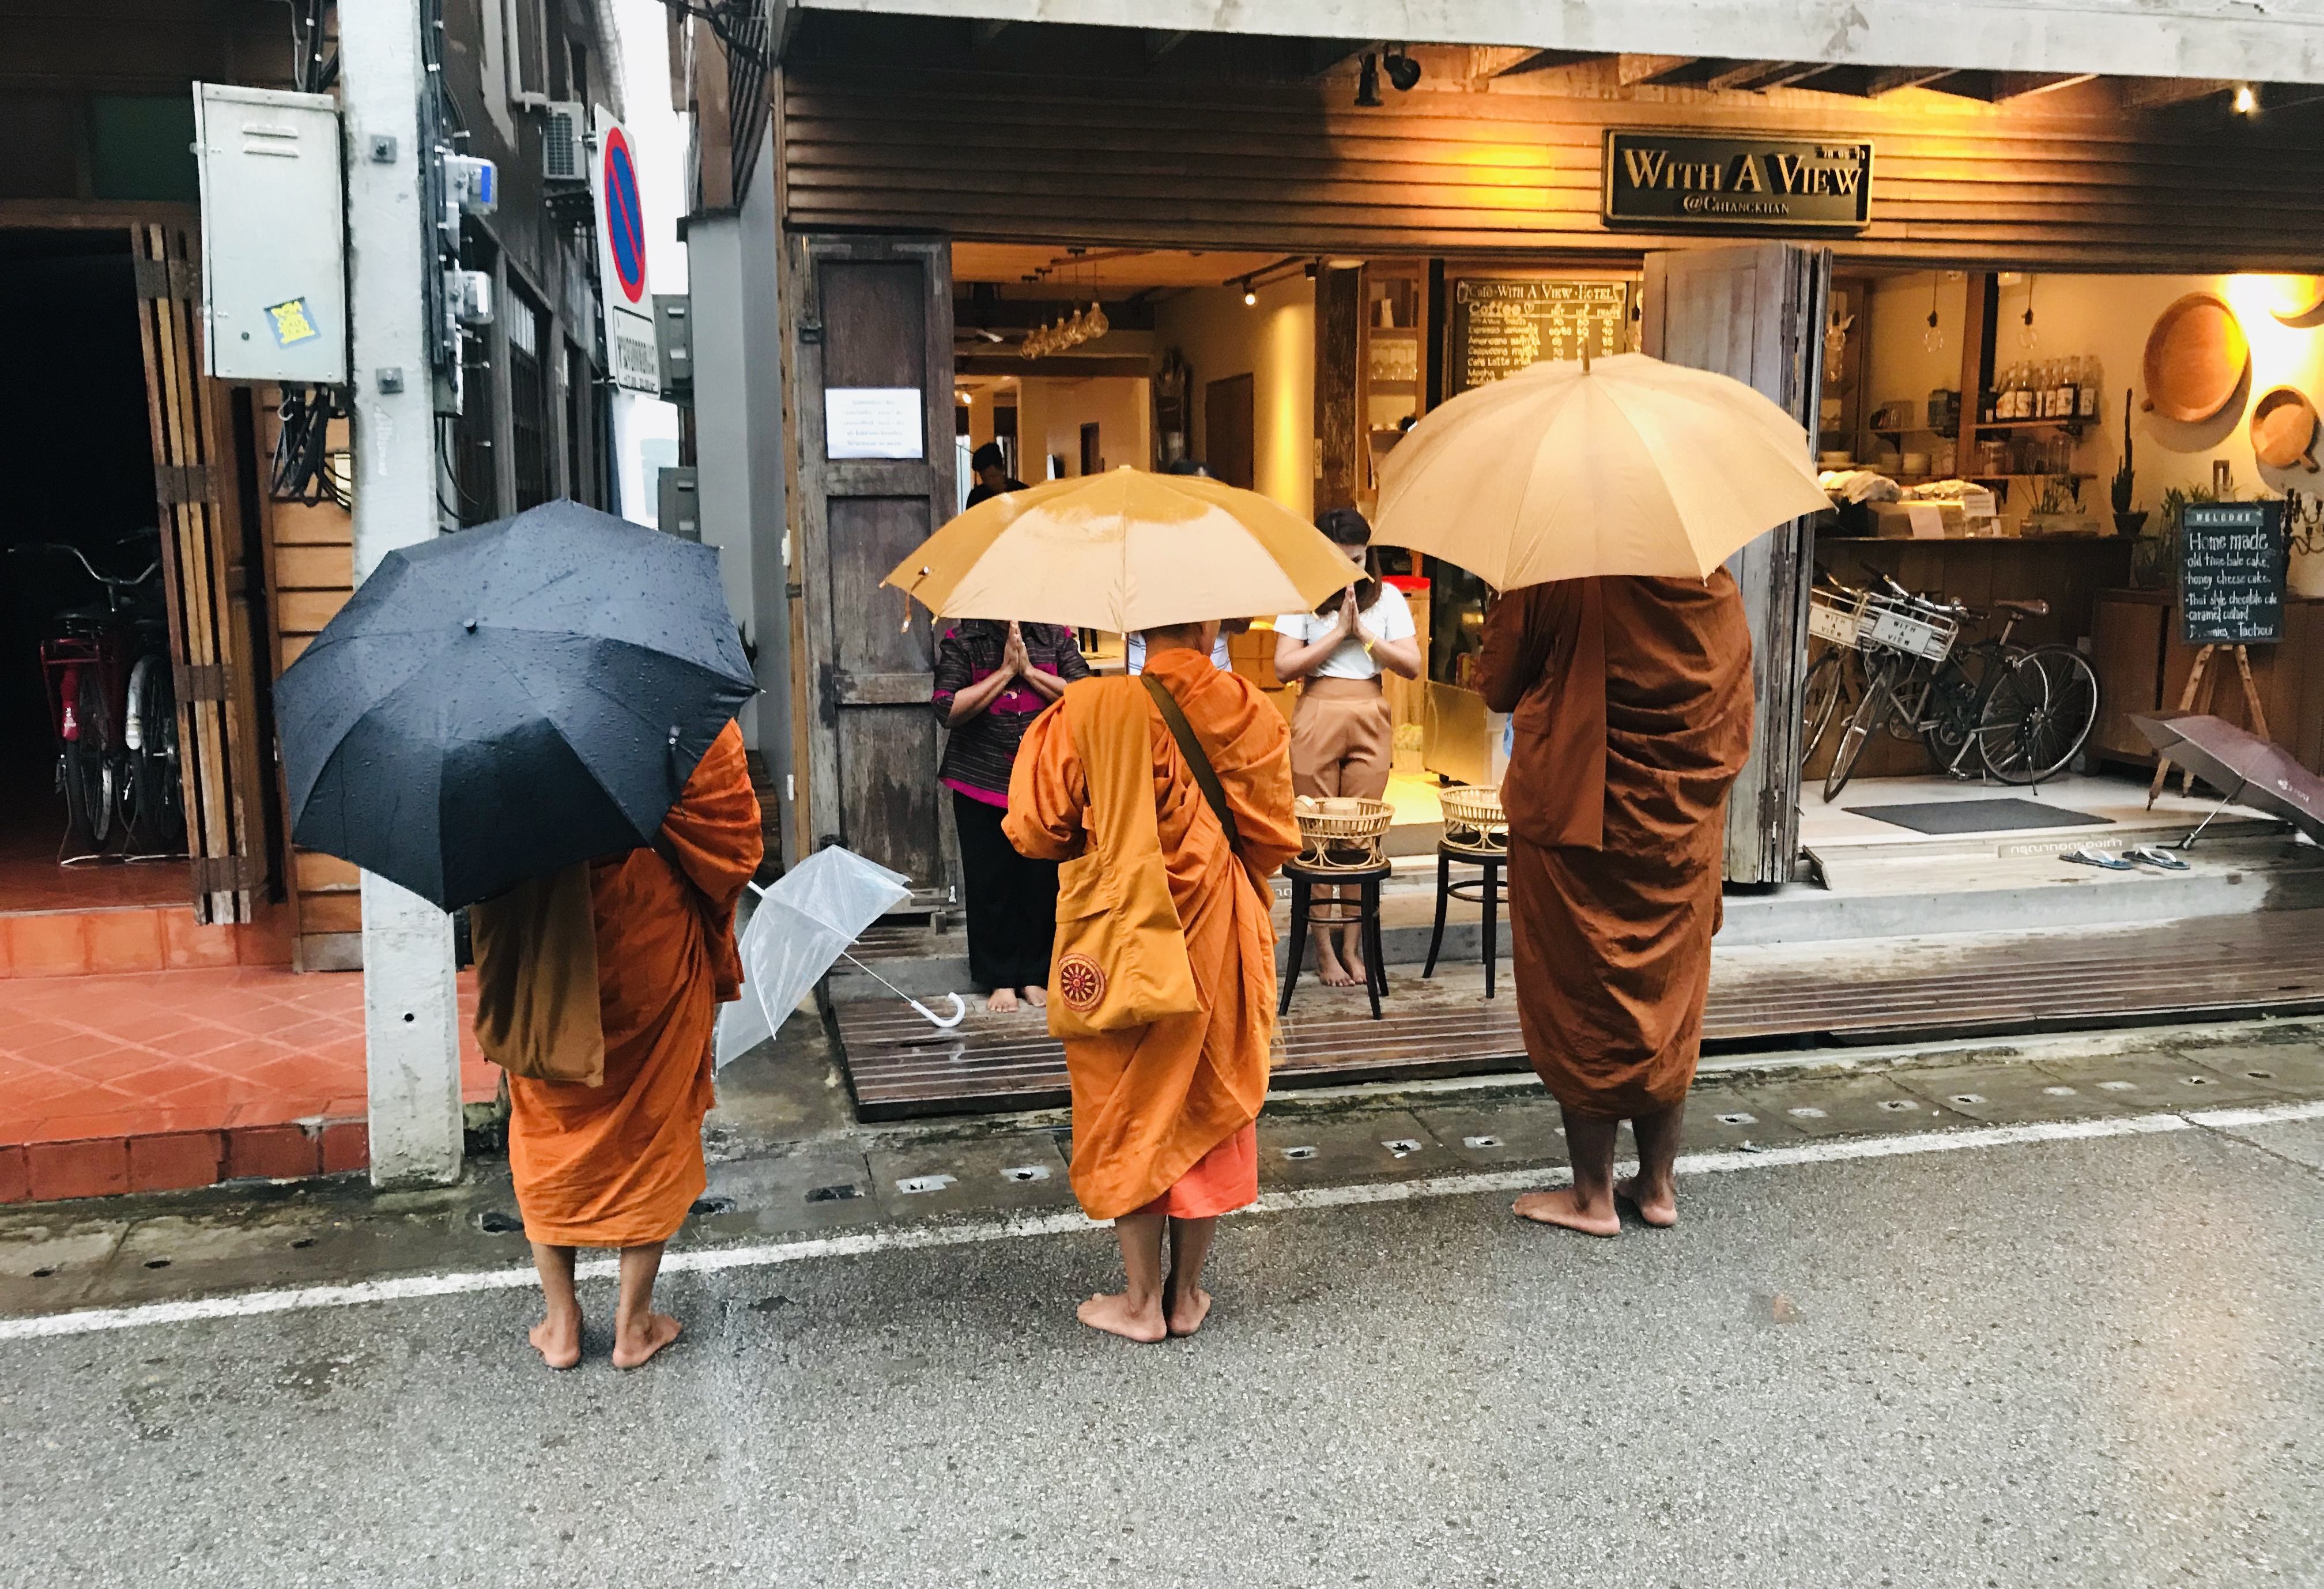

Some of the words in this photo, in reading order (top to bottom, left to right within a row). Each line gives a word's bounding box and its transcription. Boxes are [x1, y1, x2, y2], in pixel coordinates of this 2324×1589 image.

[1734, 154, 1763, 192] A
[1527, 285, 1537, 299] A
[2196, 513, 2250, 522] WELCOME
[2190, 532, 2227, 550] Home
[2229, 526, 2269, 550] made
[2217, 569, 2246, 584] cheese
[1825, 614, 1846, 625] WITH
[1821, 626, 1842, 637] VIEW
[1893, 621, 1916, 633] WITH
[1888, 634, 1910, 646] VIEW
